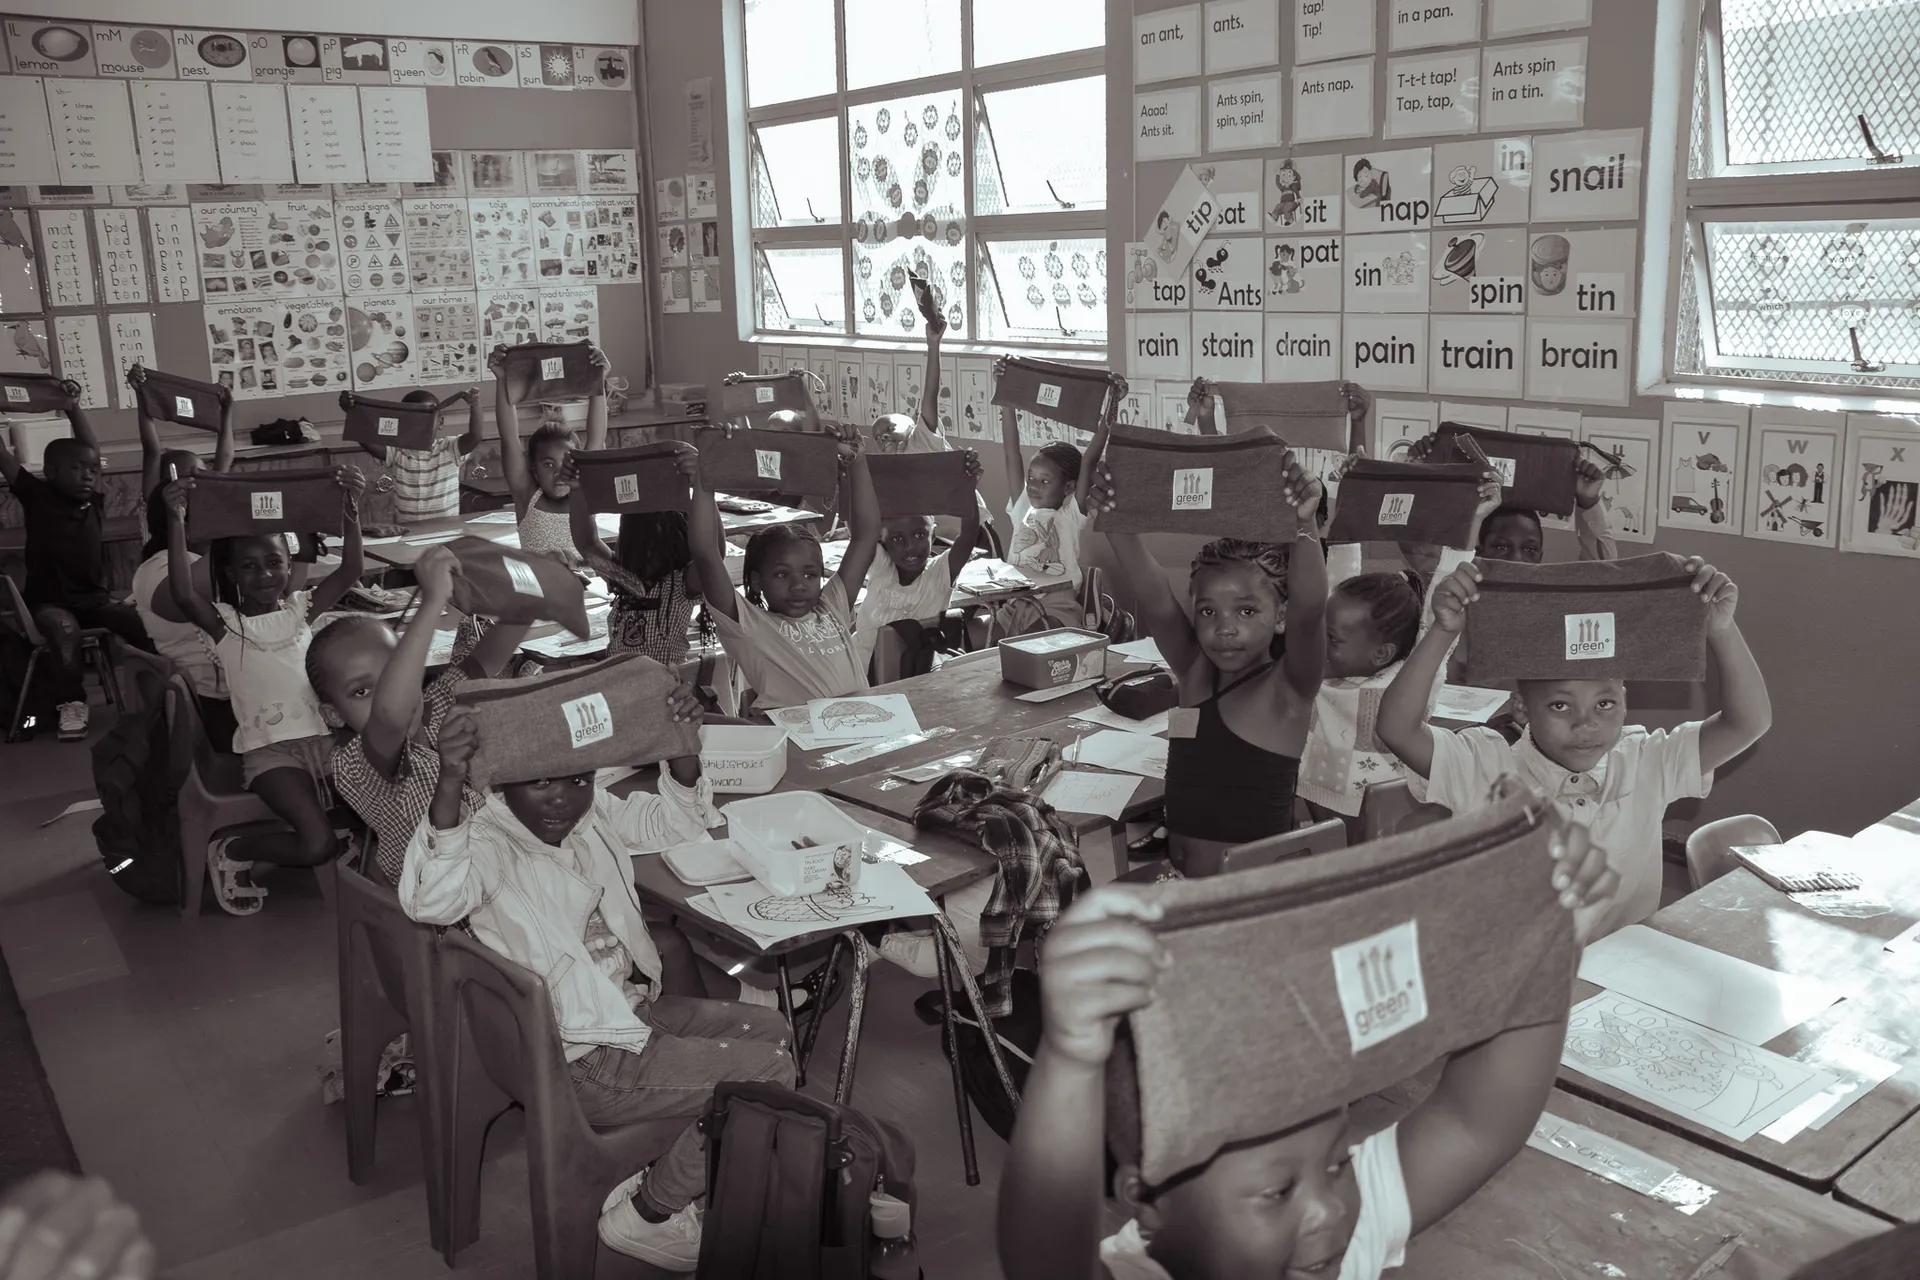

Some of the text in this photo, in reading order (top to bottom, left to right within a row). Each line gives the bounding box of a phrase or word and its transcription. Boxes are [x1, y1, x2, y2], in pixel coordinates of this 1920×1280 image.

[1303, 0, 1324, 15] tap!
[1398, 5, 1454, 24] in a pan.
[1213, 14, 1244, 33] ants.
[1302, 22, 1322, 38] Tip!
[1141, 24, 1184, 45] an ant,
[15, 55, 59, 71] lemon
[101, 63, 145, 75] mouse
[1493, 58, 1556, 77] Ants spin
[182, 65, 210, 77] nest
[255, 67, 295, 80] orange
[325, 65, 342, 80] pig
[392, 67, 426, 82] queen
[1397, 68, 1457, 88] T-t-t tap!
[459, 74, 485, 84] robin
[523, 76, 541, 86] sun
[577, 74, 595, 87] tap
[1301, 77, 1354, 95] Ants nap.
[1216, 90, 1264, 107] Ants spin,
[1492, 84, 1544, 101] in a tin.
[1141, 103, 1168, 117] Aaaa!
[1397, 94, 1454, 112] Tap, tap,
[1216, 110, 1264, 128] spin, spin!
[1141, 123, 1174, 138] Ants sit.
[1501, 144, 1526, 171] in
[1549, 153, 1625, 193] snail
[201, 203, 257, 217] our country
[287, 202, 308, 211] fruit
[345, 203, 390, 214] road signs
[430, 201, 454, 210] home
[489, 201, 508, 212] toys
[581, 200, 607, 209] people
[1304, 199, 1327, 223] sit
[1185, 200, 1213, 235] tip
[1218, 202, 1245, 225] sat
[1380, 200, 1430, 225] nap
[47, 224, 74, 235] mat
[103, 219, 129, 233] bed
[51, 238, 76, 249] cat
[106, 232, 130, 246] led
[54, 252, 78, 264] rat
[107, 248, 133, 260] met
[1301, 239, 1340, 268] pat
[54, 263, 80, 276] fat
[109, 258, 138, 273] den
[111, 272, 139, 287] bet
[1354, 262, 1382, 287] sin
[57, 278, 82, 290] sat
[57, 289, 82, 303] hat
[113, 289, 140, 301] ten
[438, 295, 460, 304] home
[492, 291, 524, 303] clothing
[540, 288, 596, 299] road transport
[1153, 281, 1186, 306] tap
[1218, 281, 1262, 306] Ants
[1470, 277, 1523, 310] spin
[1576, 284, 1616, 312] tin
[218, 306, 262, 315] emotions
[284, 300, 335, 313] vegetables
[363, 298, 396, 310] planets
[59, 331, 81, 341] cot
[117, 323, 141, 338] fun
[62, 344, 83, 355] lot
[120, 342, 143, 352] run
[1138, 332, 1179, 357] rain
[1201, 332, 1254, 358] stain
[1276, 331, 1331, 357] drain
[1355, 335, 1415, 368] pain
[1441, 339, 1513, 370] train
[1541, 338, 1618, 370] brain
[64, 358, 87, 369] not
[121, 355, 145, 364] sun
[906, 367, 912, 381] g
[972, 373, 977, 387] i
[1128, 397, 1140, 409] m
[1402, 424, 1410, 437] r
[1697, 430, 1711, 445] v
[1612, 443, 1626, 457] u
[1787, 439, 1809, 455] w
[1889, 446, 1906, 463] x
[1176, 493, 1204, 505] green
[255, 508, 277, 516] green
[1381, 511, 1402, 521] green
[1570, 641, 1605, 655] green
[575, 722, 605, 742] green
[1355, 990, 1410, 1036] green
